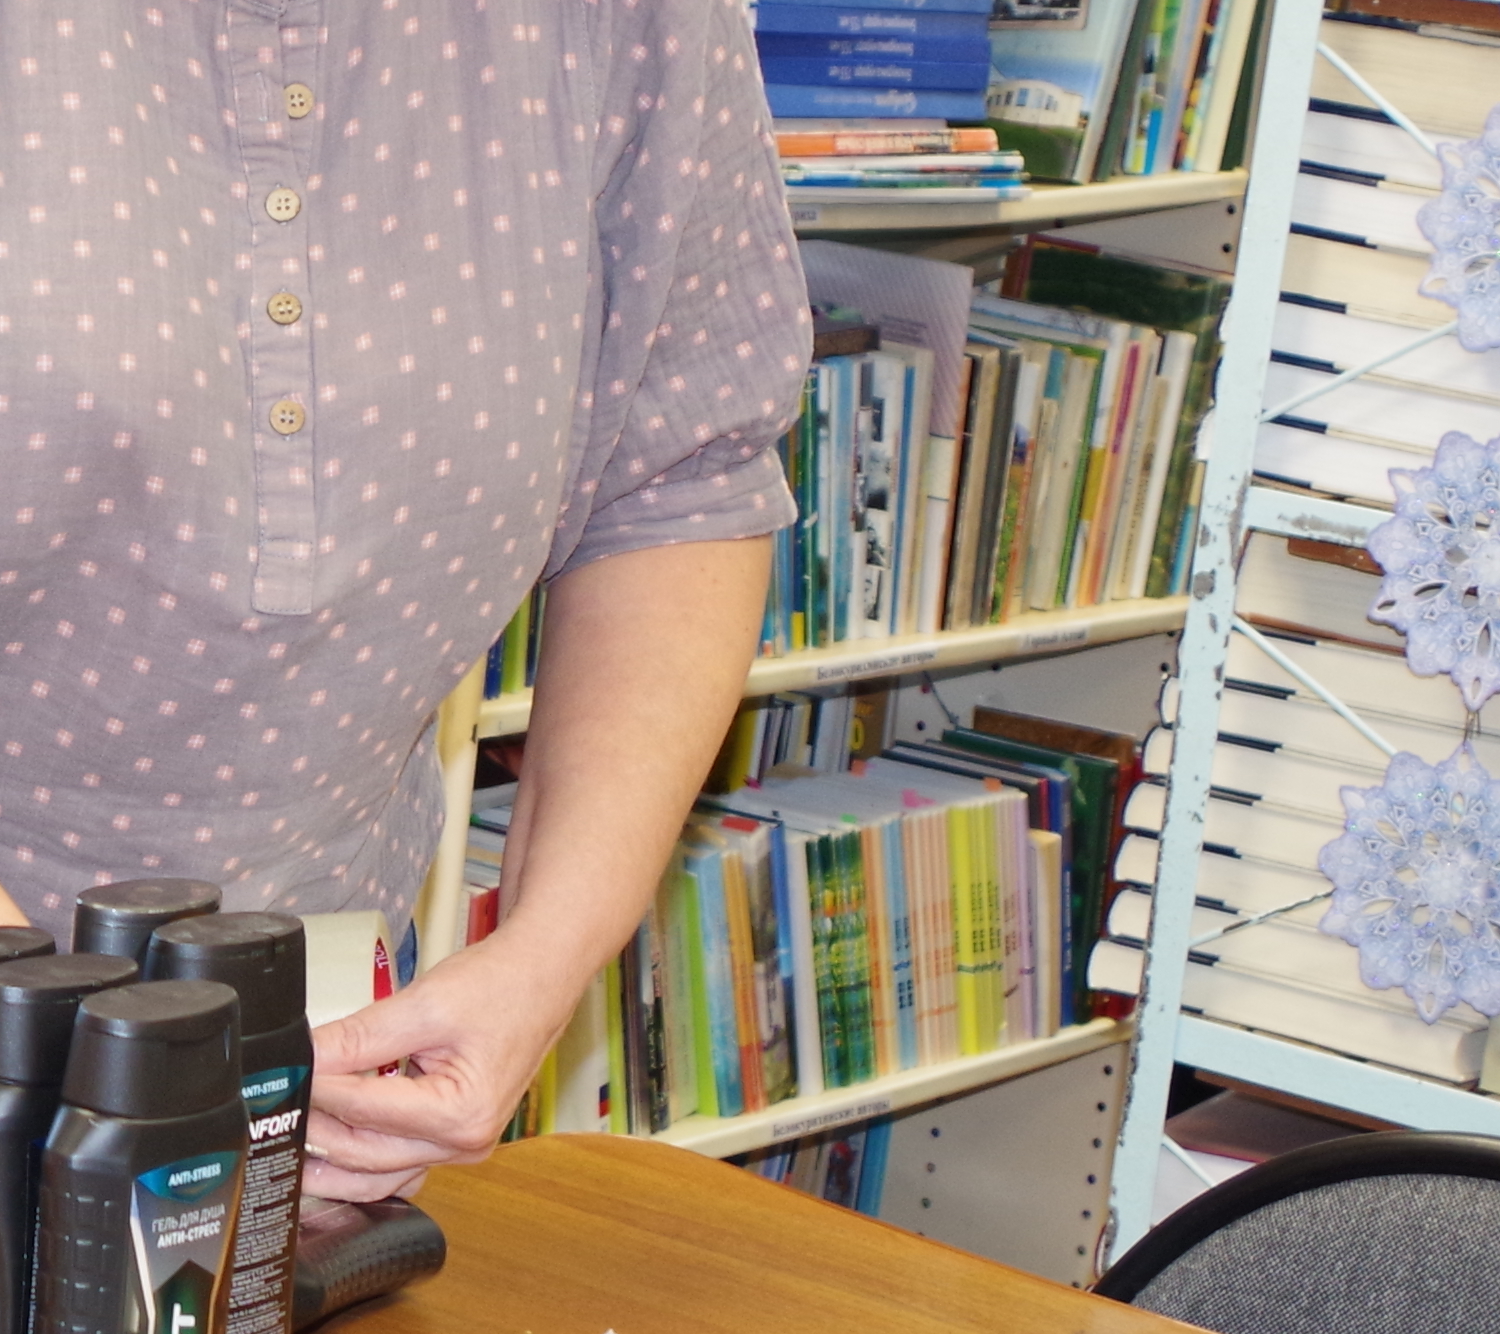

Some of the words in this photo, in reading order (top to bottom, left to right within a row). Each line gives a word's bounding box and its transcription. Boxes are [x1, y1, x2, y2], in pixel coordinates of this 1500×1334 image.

[168, 1161, 221, 1187] ANTI-STRESS
[151, 1216, 178, 1234] ГЕЛЬ
[178, 1211, 199, 1228] ДЛЯ
[198, 1203, 226, 1224] ДУША
[156, 1220, 221, 1249] АНТИ-СТРЕСС
